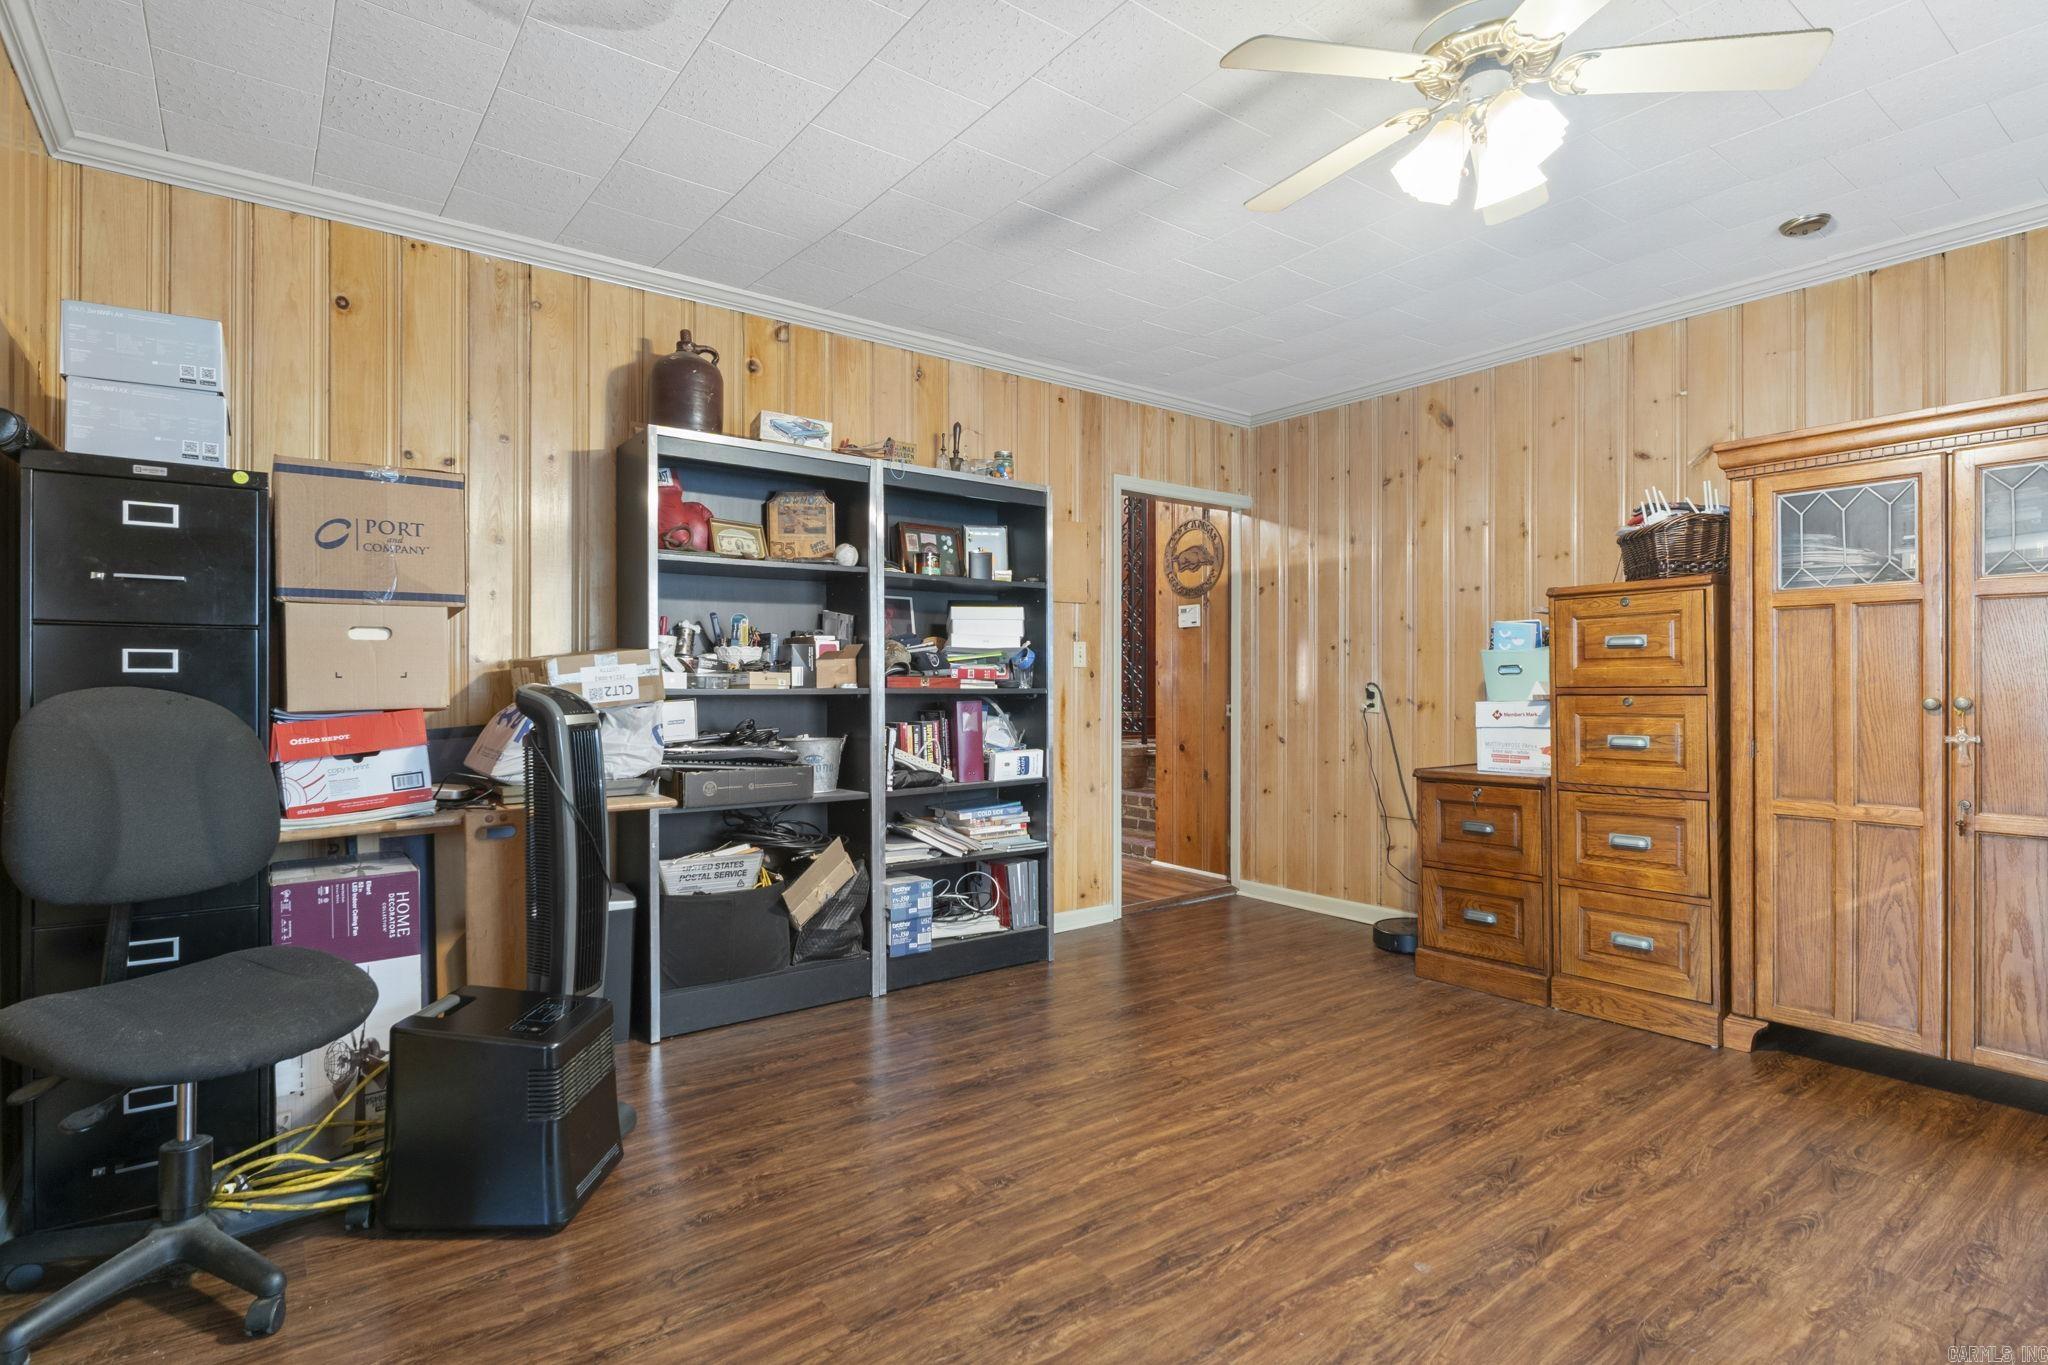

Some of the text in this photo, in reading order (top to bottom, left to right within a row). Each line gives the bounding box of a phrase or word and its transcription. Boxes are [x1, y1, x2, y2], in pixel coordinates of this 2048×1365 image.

[365, 519, 425, 538] PORT
[386, 535, 403, 544] and
[363, 542, 426, 555] COMPANY
[289, 734, 350, 746] Office DEPOT
[327, 767, 346, 776] copy
[296, 806, 325, 815] standard
[714, 860, 745, 870] STATES
[679, 869, 748, 882] POSTAL SERVICE
[351, 909, 359, 926] Ceiling
[388, 892, 396, 938] DECORATORS
[396, 891, 410, 938] HOME
[892, 921, 911, 929] brother
